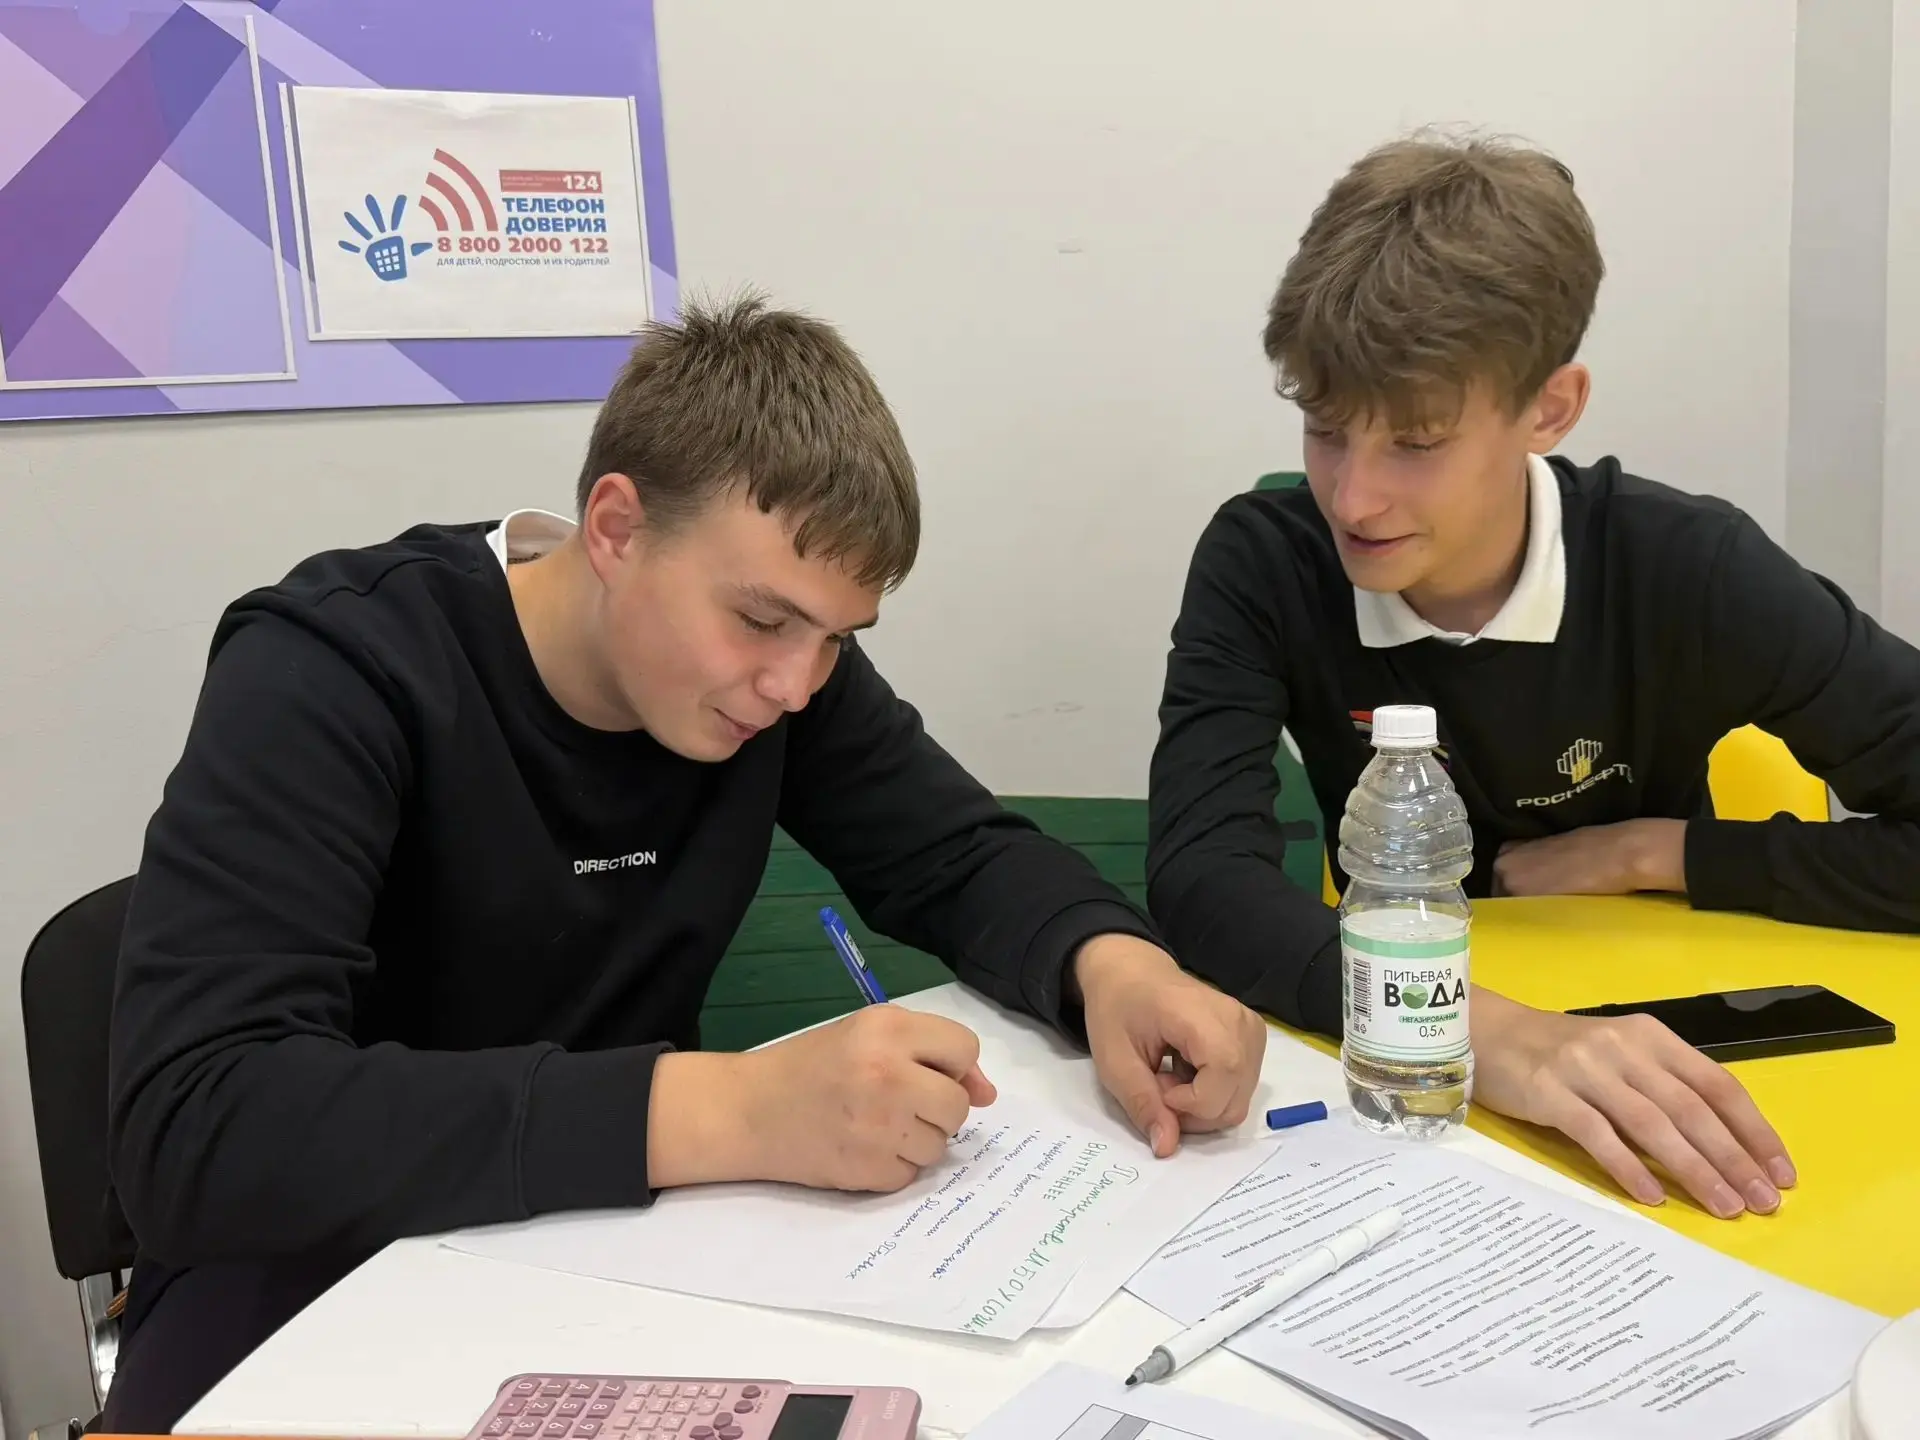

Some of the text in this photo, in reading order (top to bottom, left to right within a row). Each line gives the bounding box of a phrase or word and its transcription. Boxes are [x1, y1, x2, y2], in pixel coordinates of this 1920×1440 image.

[562, 174, 600, 191] 124
[501, 197, 605, 214] ТЕЛЕФОН
[505, 216, 607, 235] ДОВЕРИЯ
[437, 237, 608, 253] 8 800 2000 122
[437, 258, 454, 266] ДЛЯ
[456, 257, 483, 266] ДЕТЕЙ,
[485, 258, 541, 266] ПОДРОСТКОВ
[564, 257, 610, 266] РОДИТЕЛЕЙ
[574, 851, 656, 874] DIRECTION
[1384, 968, 1452, 983] ПИТЬЕВАЯ
[1402, 1012, 1457, 1023] НЕГАЗИРОВАННАЯ
[845, 1240, 897, 1280] Первых
